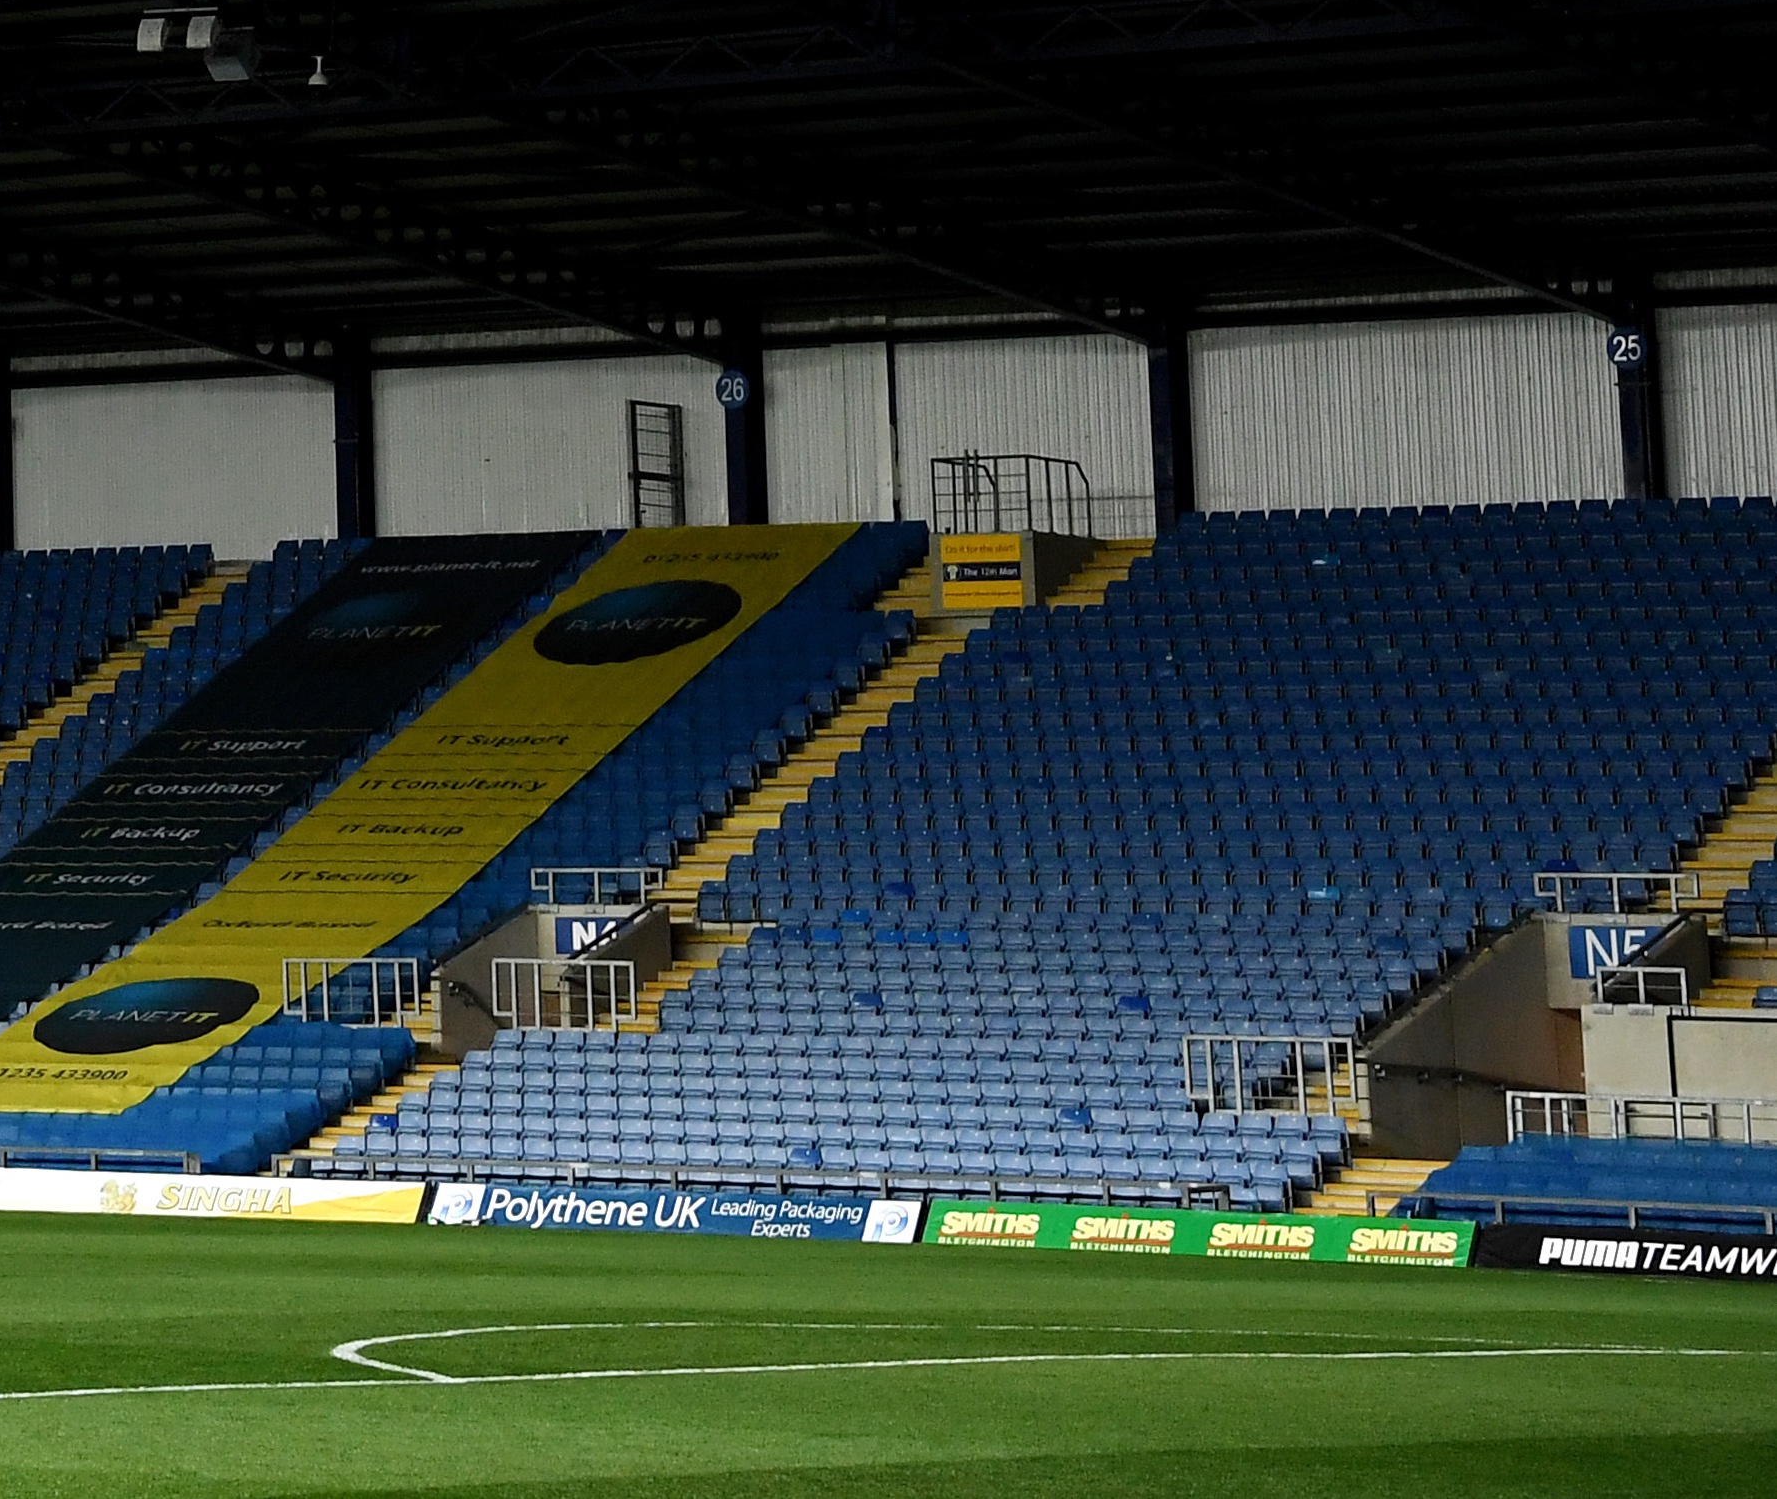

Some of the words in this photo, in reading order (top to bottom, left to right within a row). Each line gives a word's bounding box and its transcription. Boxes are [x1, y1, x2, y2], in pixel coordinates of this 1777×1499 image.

[1612, 334, 1642, 362] 25
[720, 377, 745, 402] 26
[179, 739, 207, 751] IT
[208, 739, 308, 753] Support
[437, 734, 466, 745] IT
[467, 734, 570, 748] Support
[103, 782, 132, 795] IT
[133, 781, 284, 797] Consultancy
[358, 779, 388, 790] IT
[390, 777, 547, 793] Consultancy
[80, 826, 109, 838] IT
[110, 826, 200, 841] Backup
[337, 823, 367, 834] IT
[367, 823, 464, 837] Backup
[23, 873, 52, 883] IT
[53, 872, 155, 886] Security
[279, 871, 309, 882] IT
[310, 871, 418, 884] Security
[51, 1069, 129, 1081] 433900
[155, 1183, 292, 1215] SINGHA
[486, 1187, 649, 1229] Polythene
[654, 1194, 706, 1229] UK
[710, 1198, 777, 1219] Leading
[778, 1200, 864, 1224] Packaging
[941, 1209, 1040, 1235] SMITHS
[750, 1220, 811, 1239] Experts
[1072, 1214, 1176, 1241] SMITHS
[1209, 1221, 1315, 1248] SMITHS
[1349, 1226, 1458, 1253] SMITHS
[1539, 1236, 1777, 1277] PUMATEAMW
